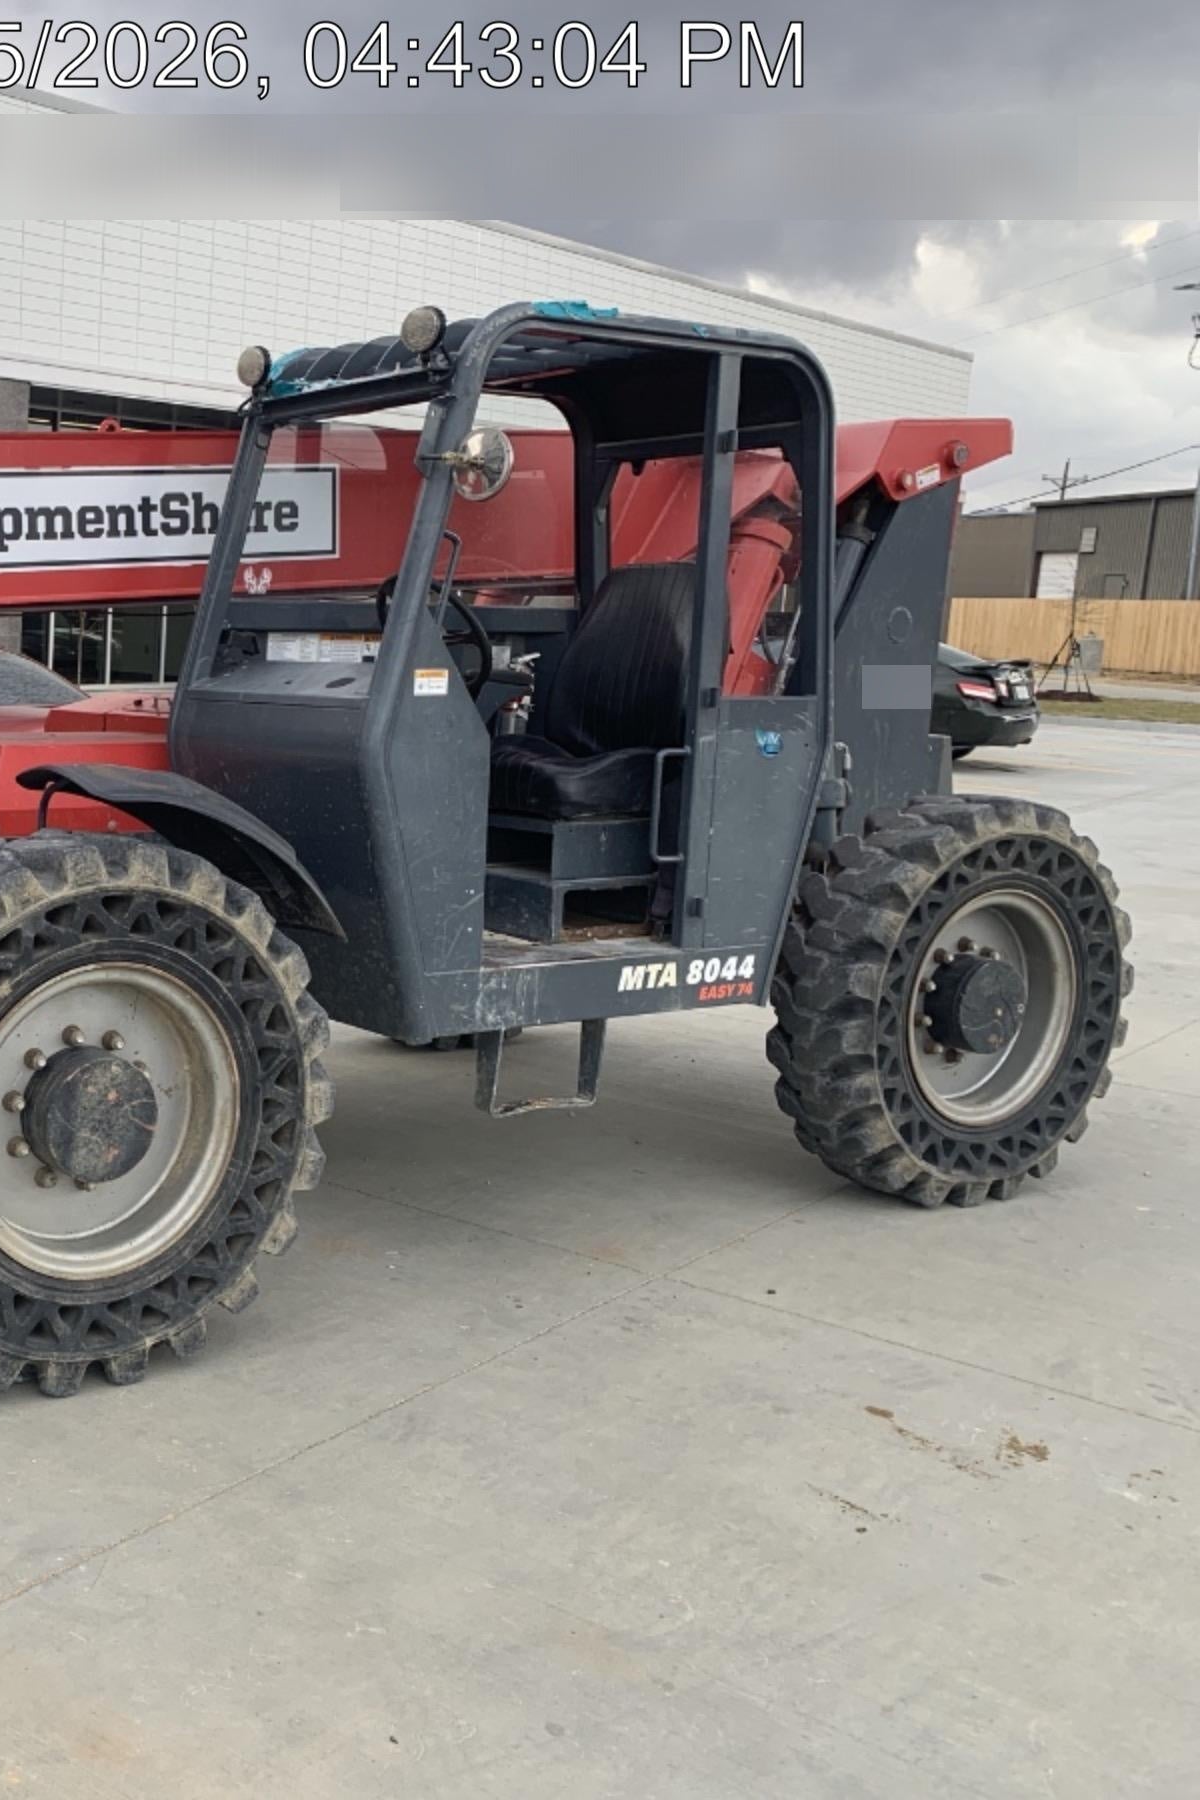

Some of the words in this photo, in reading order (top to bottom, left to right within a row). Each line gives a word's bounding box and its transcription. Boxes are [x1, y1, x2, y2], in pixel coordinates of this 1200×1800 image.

[617, 961, 677, 992] MTA
[685, 954, 756, 985] 8044
[698, 983, 737, 1001] EASY
